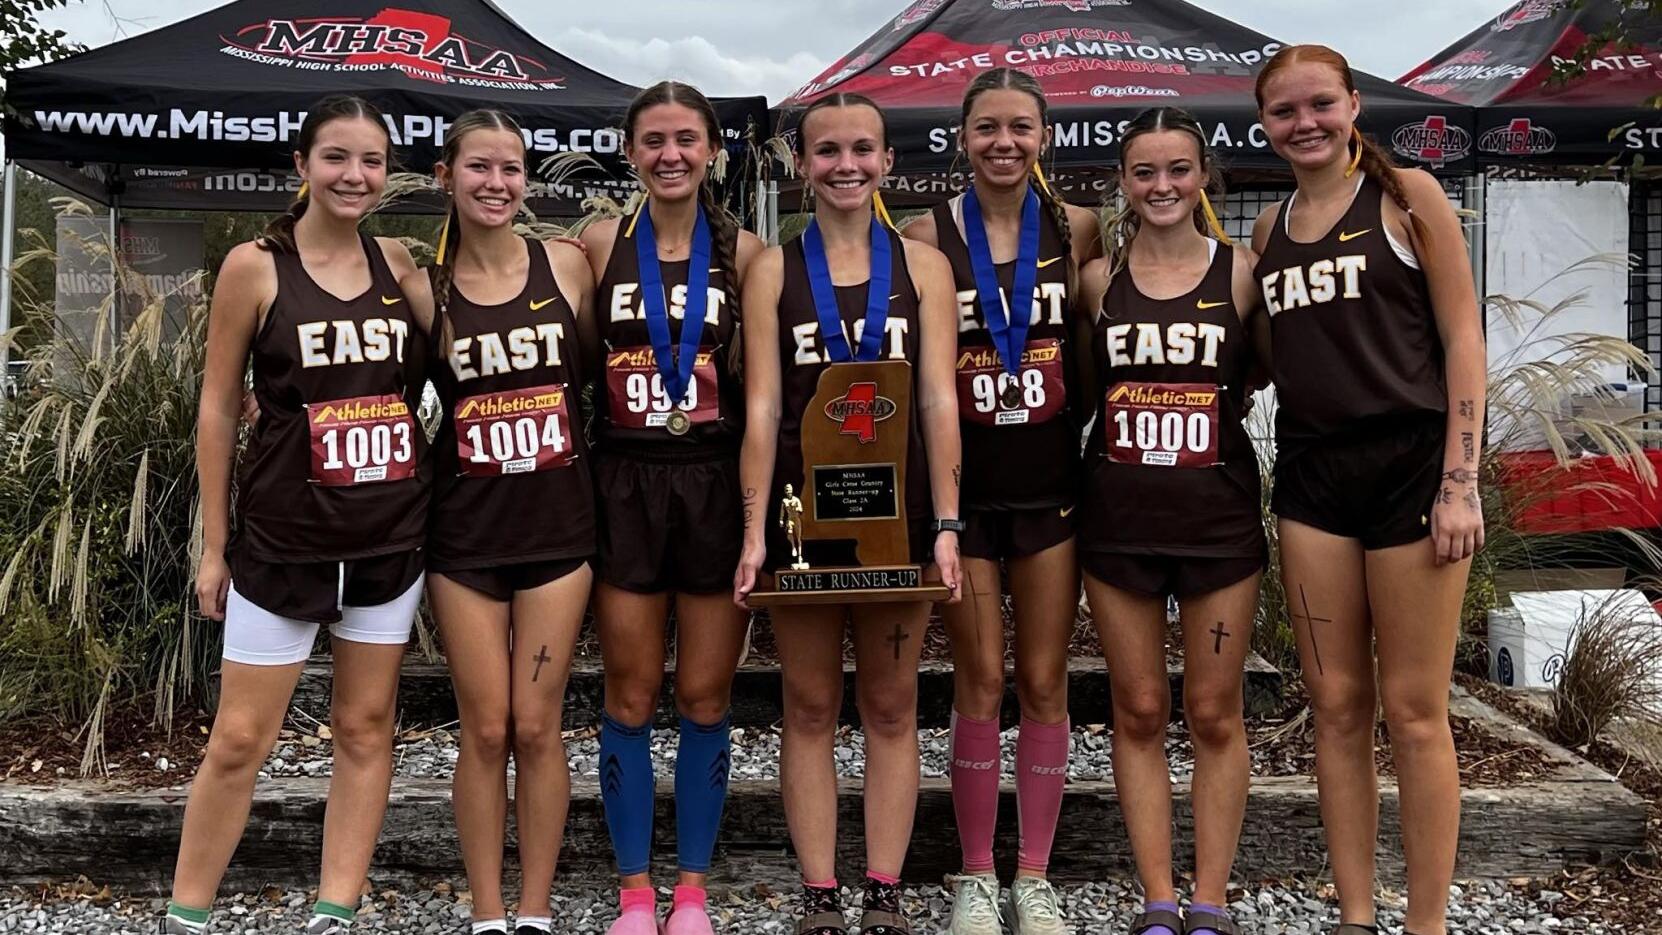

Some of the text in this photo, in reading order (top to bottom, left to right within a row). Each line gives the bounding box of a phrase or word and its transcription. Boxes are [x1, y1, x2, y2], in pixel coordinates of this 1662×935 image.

[257, 20, 529, 80] MHSAA
[1020, 27, 1141, 47] OFFICIAL
[219, 45, 293, 68] MISSISSIPPI
[295, 61, 331, 71] HIGH
[334, 62, 387, 72] SCHOOL
[390, 62, 456, 83] ACTIVITIES
[889, 52, 994, 77] STATE
[1013, 58, 1189, 78] RCHANDISE
[610, 282, 726, 326] EST
[956, 282, 1066, 333] ET
[1262, 254, 1367, 318] EAST
[297, 318, 408, 369] EAST
[449, 322, 565, 382] EAST
[792, 316, 909, 366] ET
[1106, 322, 1226, 368] EAST
[313, 401, 389, 424] Athletic
[457, 396, 536, 419] Athletic
[626, 373, 698, 413] 999
[830, 400, 886, 416] MHSAA
[1108, 385, 1186, 406] Athletic
[322, 422, 411, 470] 1003
[466, 413, 566, 463] 1004
[1114, 410, 1210, 453] 1000
[781, 570, 917, 591] STATE RUNNER-UP
